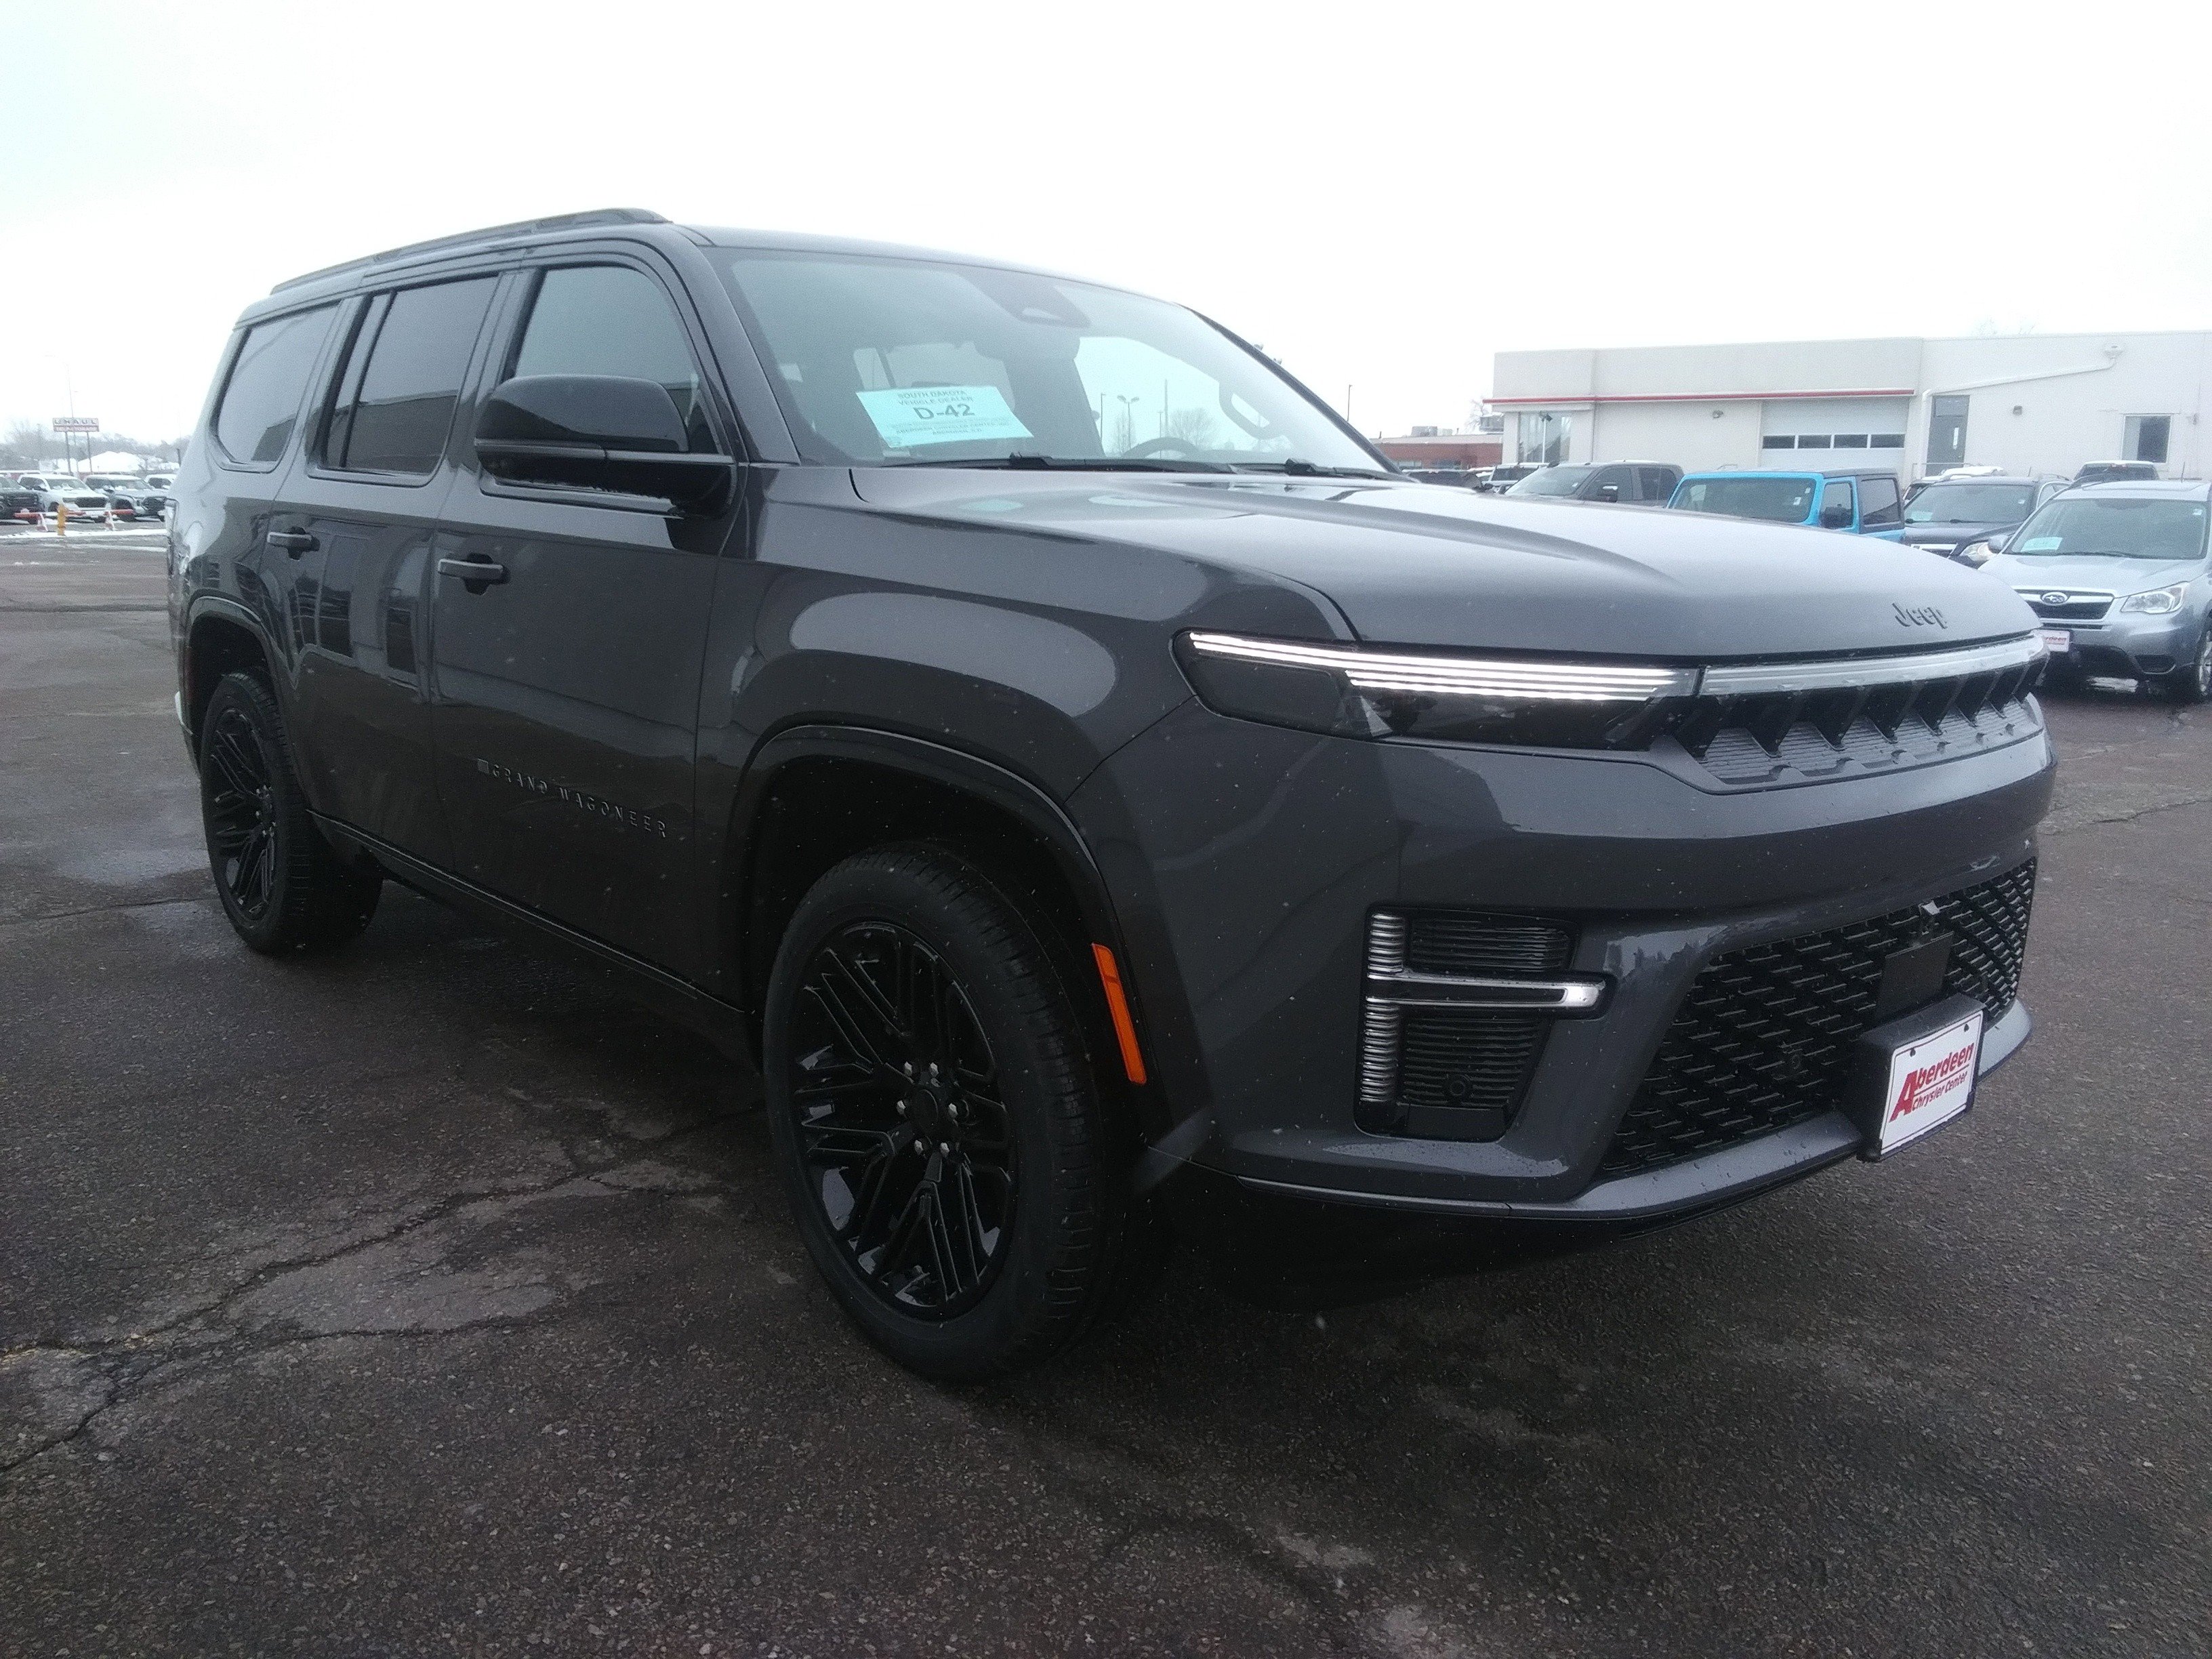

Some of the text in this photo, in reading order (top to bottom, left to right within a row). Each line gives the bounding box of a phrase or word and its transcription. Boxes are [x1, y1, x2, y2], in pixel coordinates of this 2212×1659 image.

[913, 403, 975, 420] D-42
[1892, 602, 1948, 629] Jeep
[493, 764, 666, 838] GRAND WAGONEER
[1889, 1042, 1975, 1123] Aberdeen
[1912, 1071, 1968, 1111] Chrysler Center
